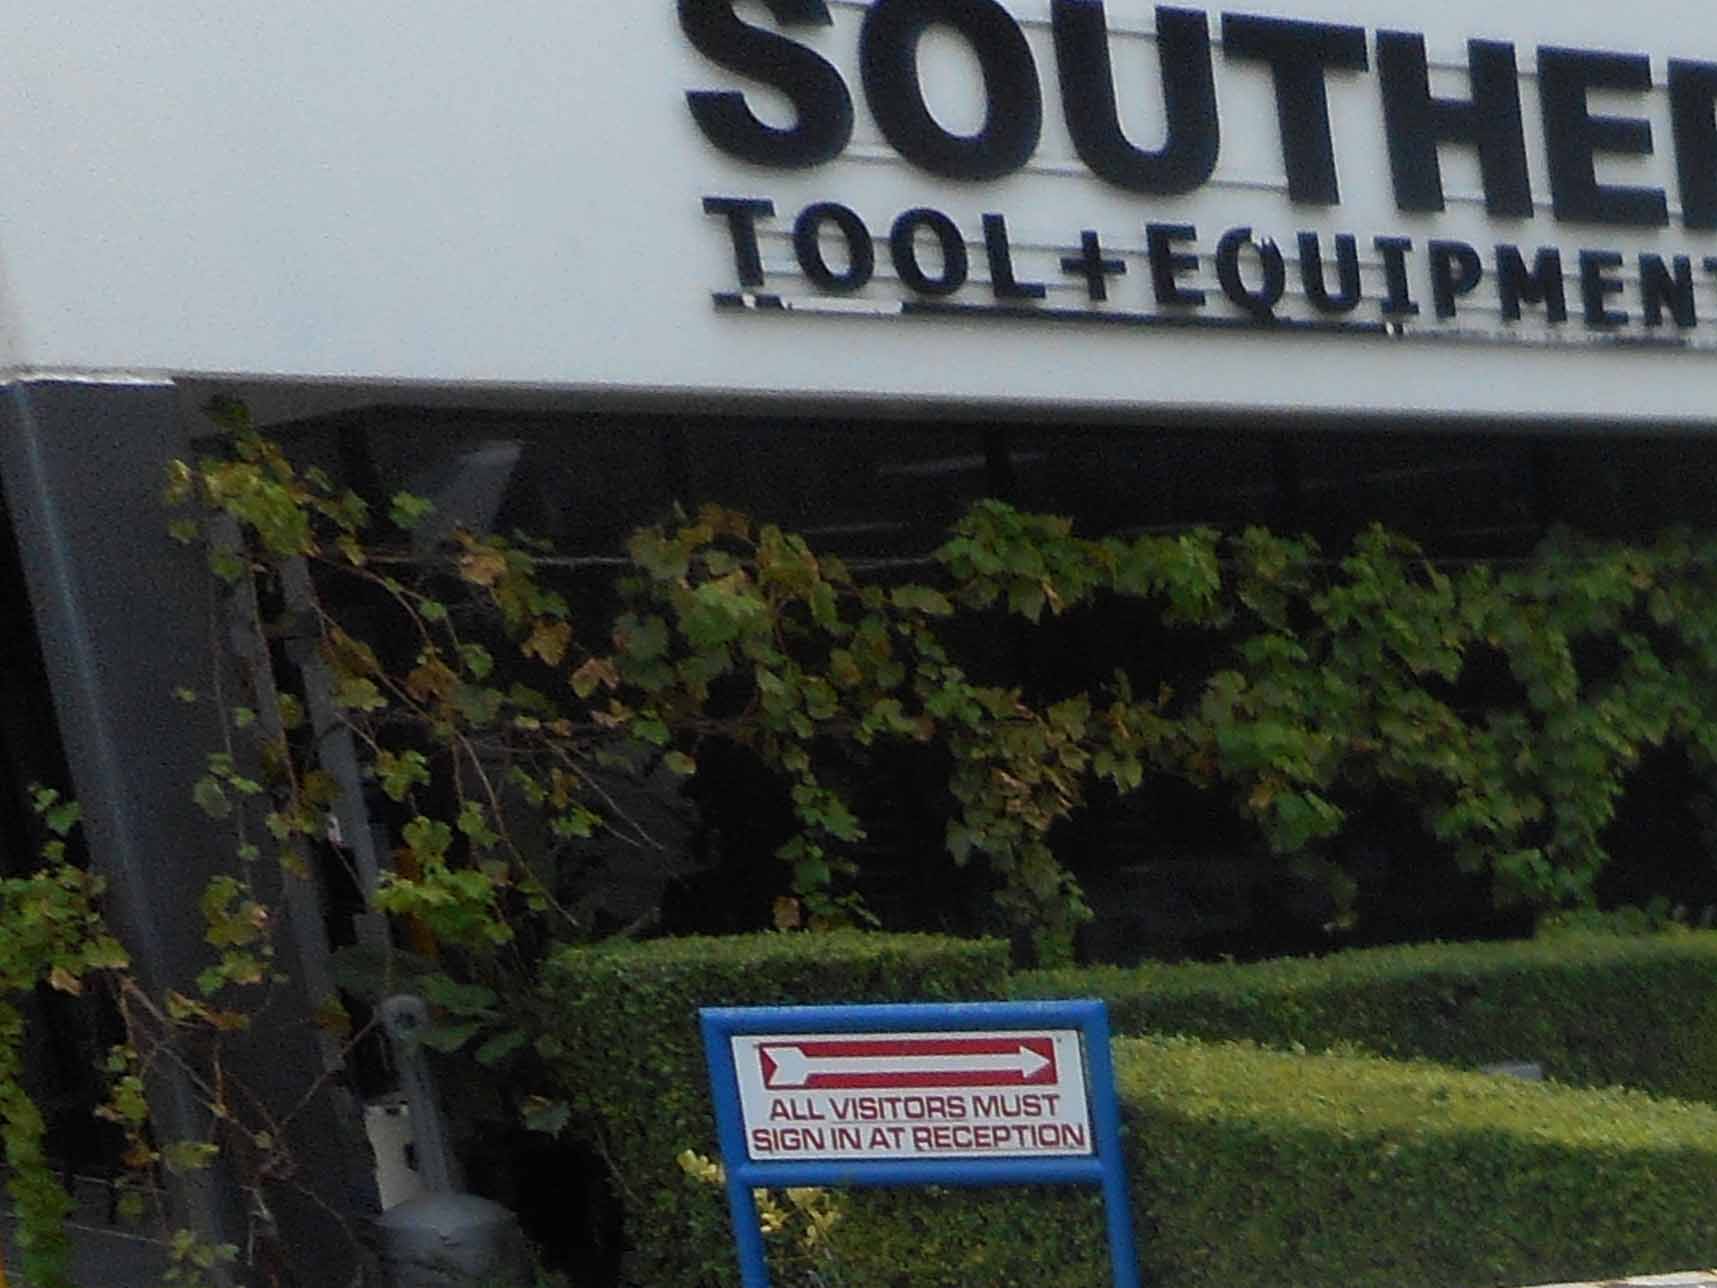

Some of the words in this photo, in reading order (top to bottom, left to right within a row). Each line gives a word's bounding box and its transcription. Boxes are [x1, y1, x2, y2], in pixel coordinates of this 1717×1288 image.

[770, 1098, 825, 1122] ALL
[830, 1096, 968, 1121] VISITORS
[972, 1094, 1061, 1117] MUST
[751, 1127, 825, 1152] SIGN
[832, 1127, 862, 1151] IN
[868, 1126, 906, 1149] AT
[912, 1124, 1086, 1150] RECEPTION
